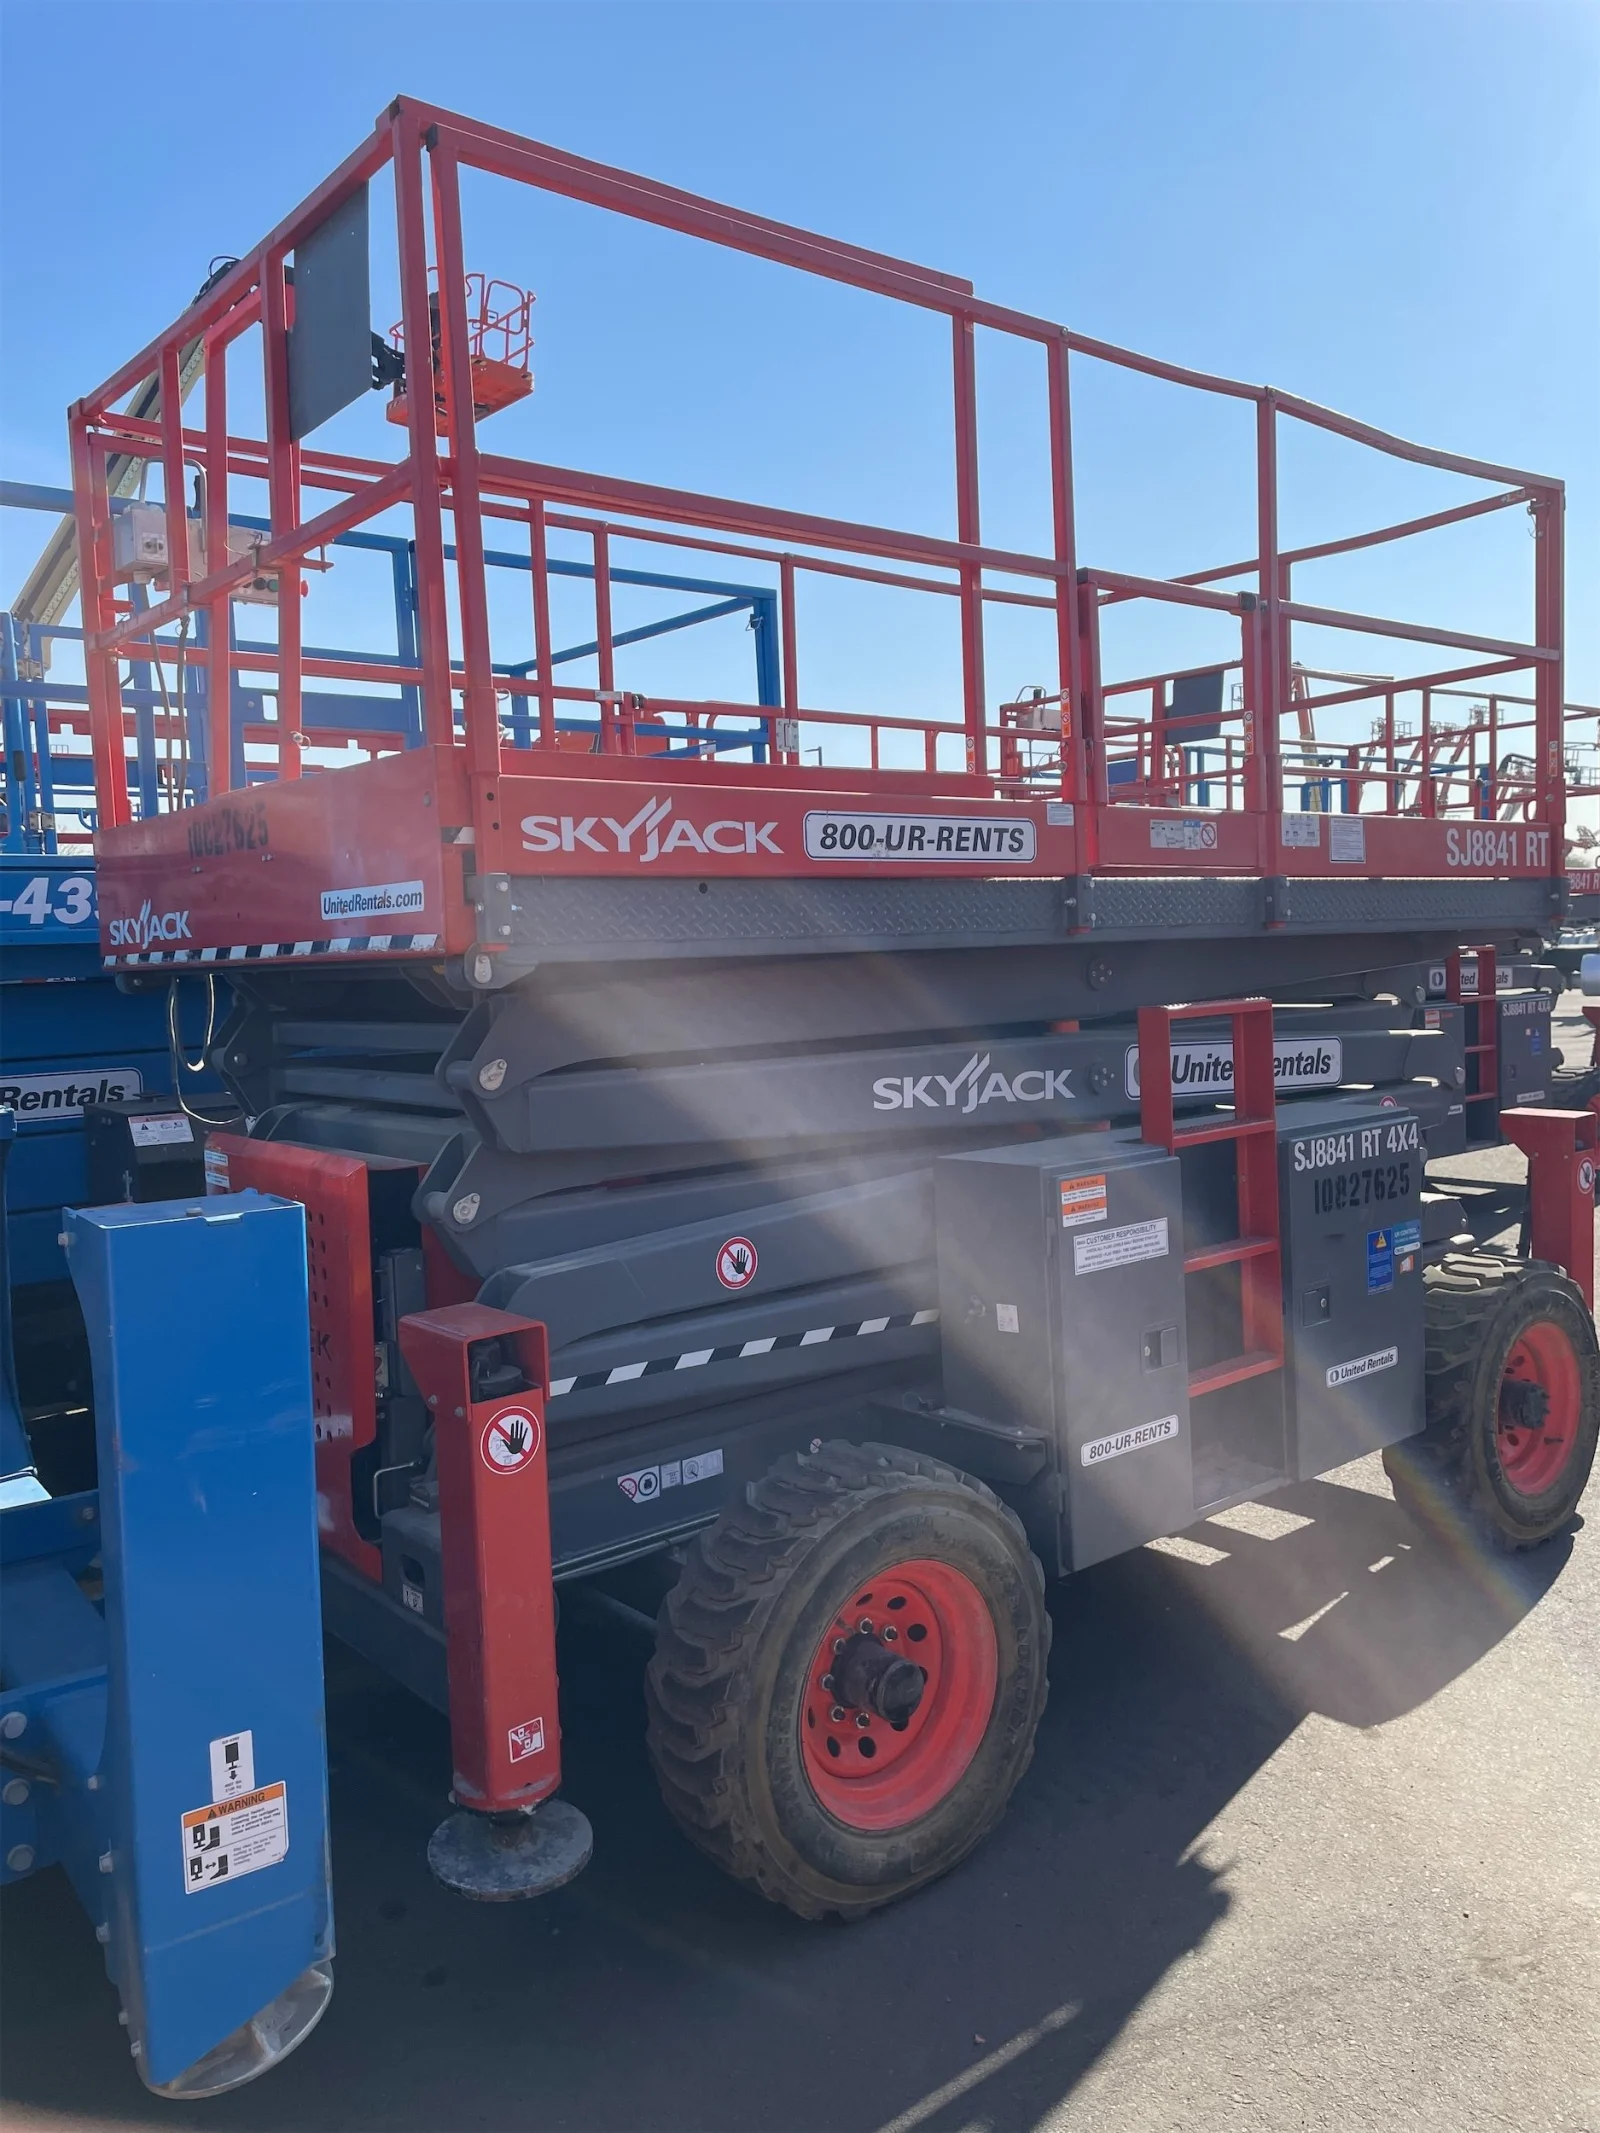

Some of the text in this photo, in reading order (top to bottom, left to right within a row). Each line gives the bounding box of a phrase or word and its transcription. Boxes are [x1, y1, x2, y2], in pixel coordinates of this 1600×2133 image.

[521, 796, 785, 863] SKYJACK
[820, 823, 1025, 854] 800-UR-RENTS
[1446, 828, 1549, 866] SJ8841 RT
[0, 877, 99, 924] -43
[323, 891, 422, 914] UnitedRentals.com
[109, 898, 192, 950] SKYJACK
[873, 1052, 1076, 1114] SKYJACK
[1171, 1048, 1331, 1084] Unite entals
[0, 1079, 125, 1112] Rentals
[1294, 1122, 1419, 1172] SJ8841 RT 4X4
[1314, 1162, 1410, 1214] 10827625
[1086, 1231, 1115, 1245] CUSTOMER
[1116, 1224, 1157, 1239] RESPONSIBILITY
[1341, 1351, 1394, 1380] United Rentals
[1090, 1420, 1171, 1459] 800-UR-RENTS
[218, 1792, 265, 1815] WARNING
